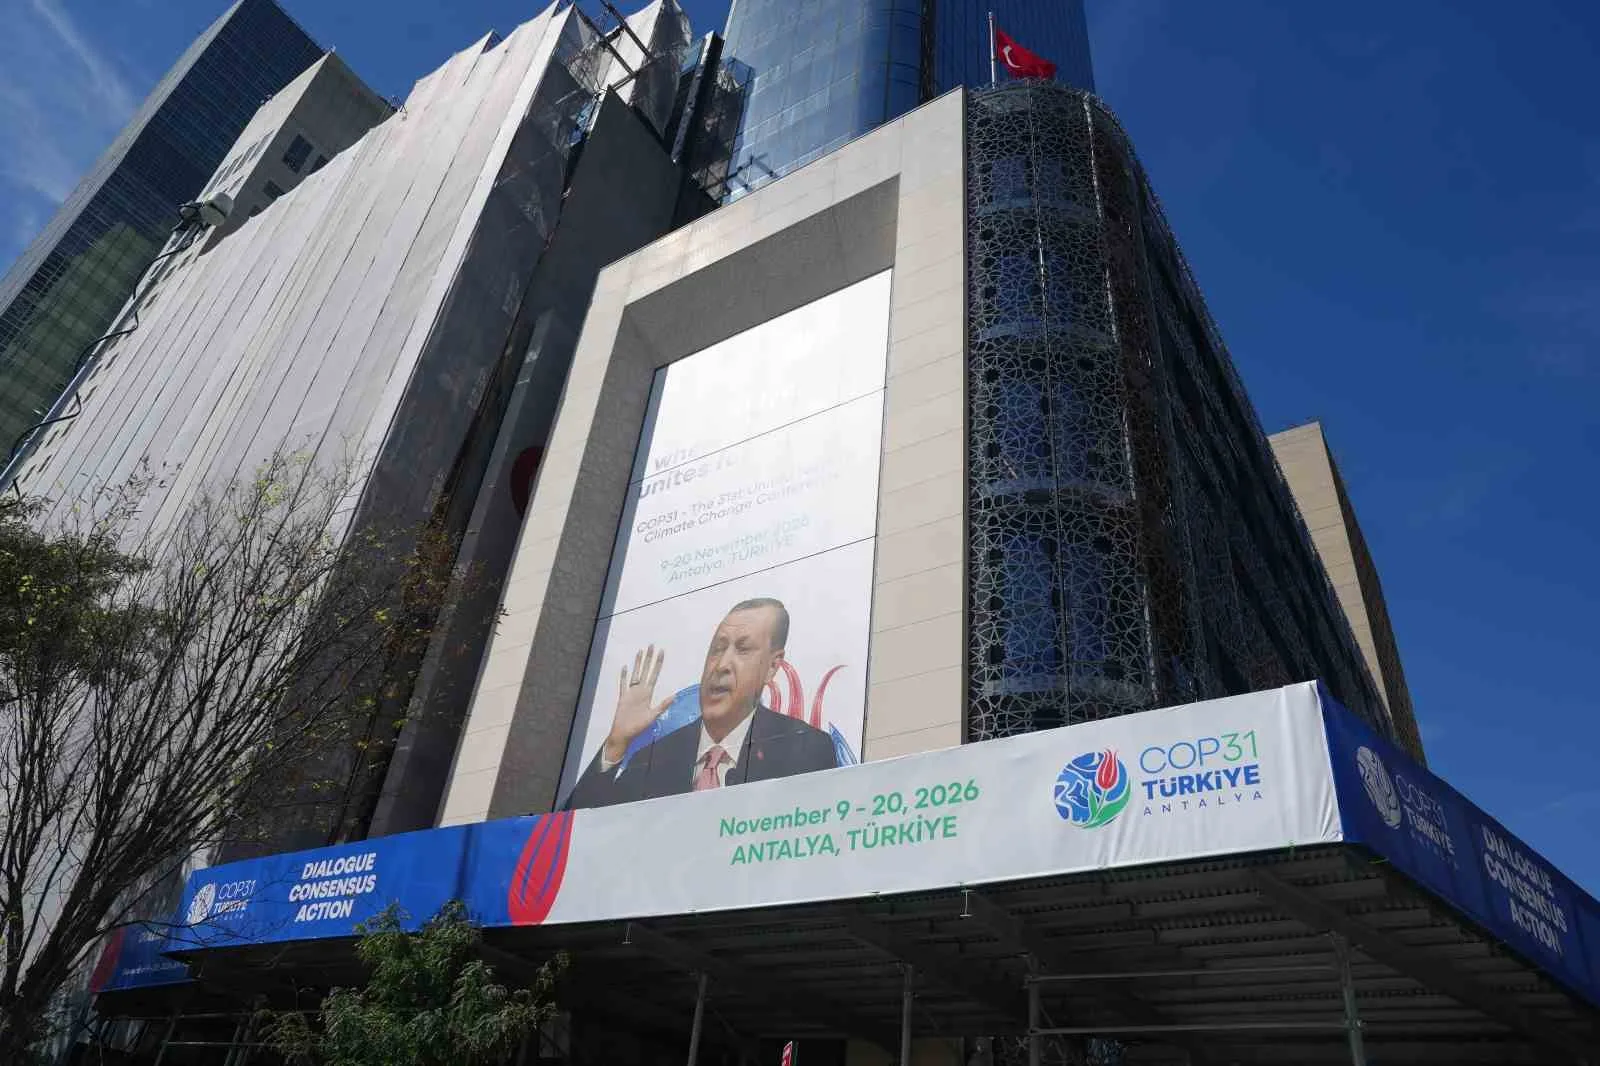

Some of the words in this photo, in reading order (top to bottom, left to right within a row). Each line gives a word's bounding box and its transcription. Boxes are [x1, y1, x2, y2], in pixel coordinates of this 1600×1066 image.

[643, 519, 696, 544] Climate
[1140, 730, 1258, 773] COP31
[1142, 764, 1260, 800] TÜRKİYE
[719, 807, 831, 837] November
[836, 800, 850, 820] 9
[872, 792, 908, 816] 20,
[915, 780, 979, 809] 2026
[1144, 791, 1262, 816] ANTALYA
[730, 834, 841, 865] ANTALYA,
[847, 814, 957, 850] TÜRKİYE
[301, 853, 376, 879] DIALOGUE
[1481, 823, 1554, 898] DIALOGUE
[288, 875, 377, 902] CONSENSUS
[1484, 852, 1567, 933] CONSENSUS
[294, 899, 355, 923] ACTION
[1509, 897, 1562, 954] ACTION
